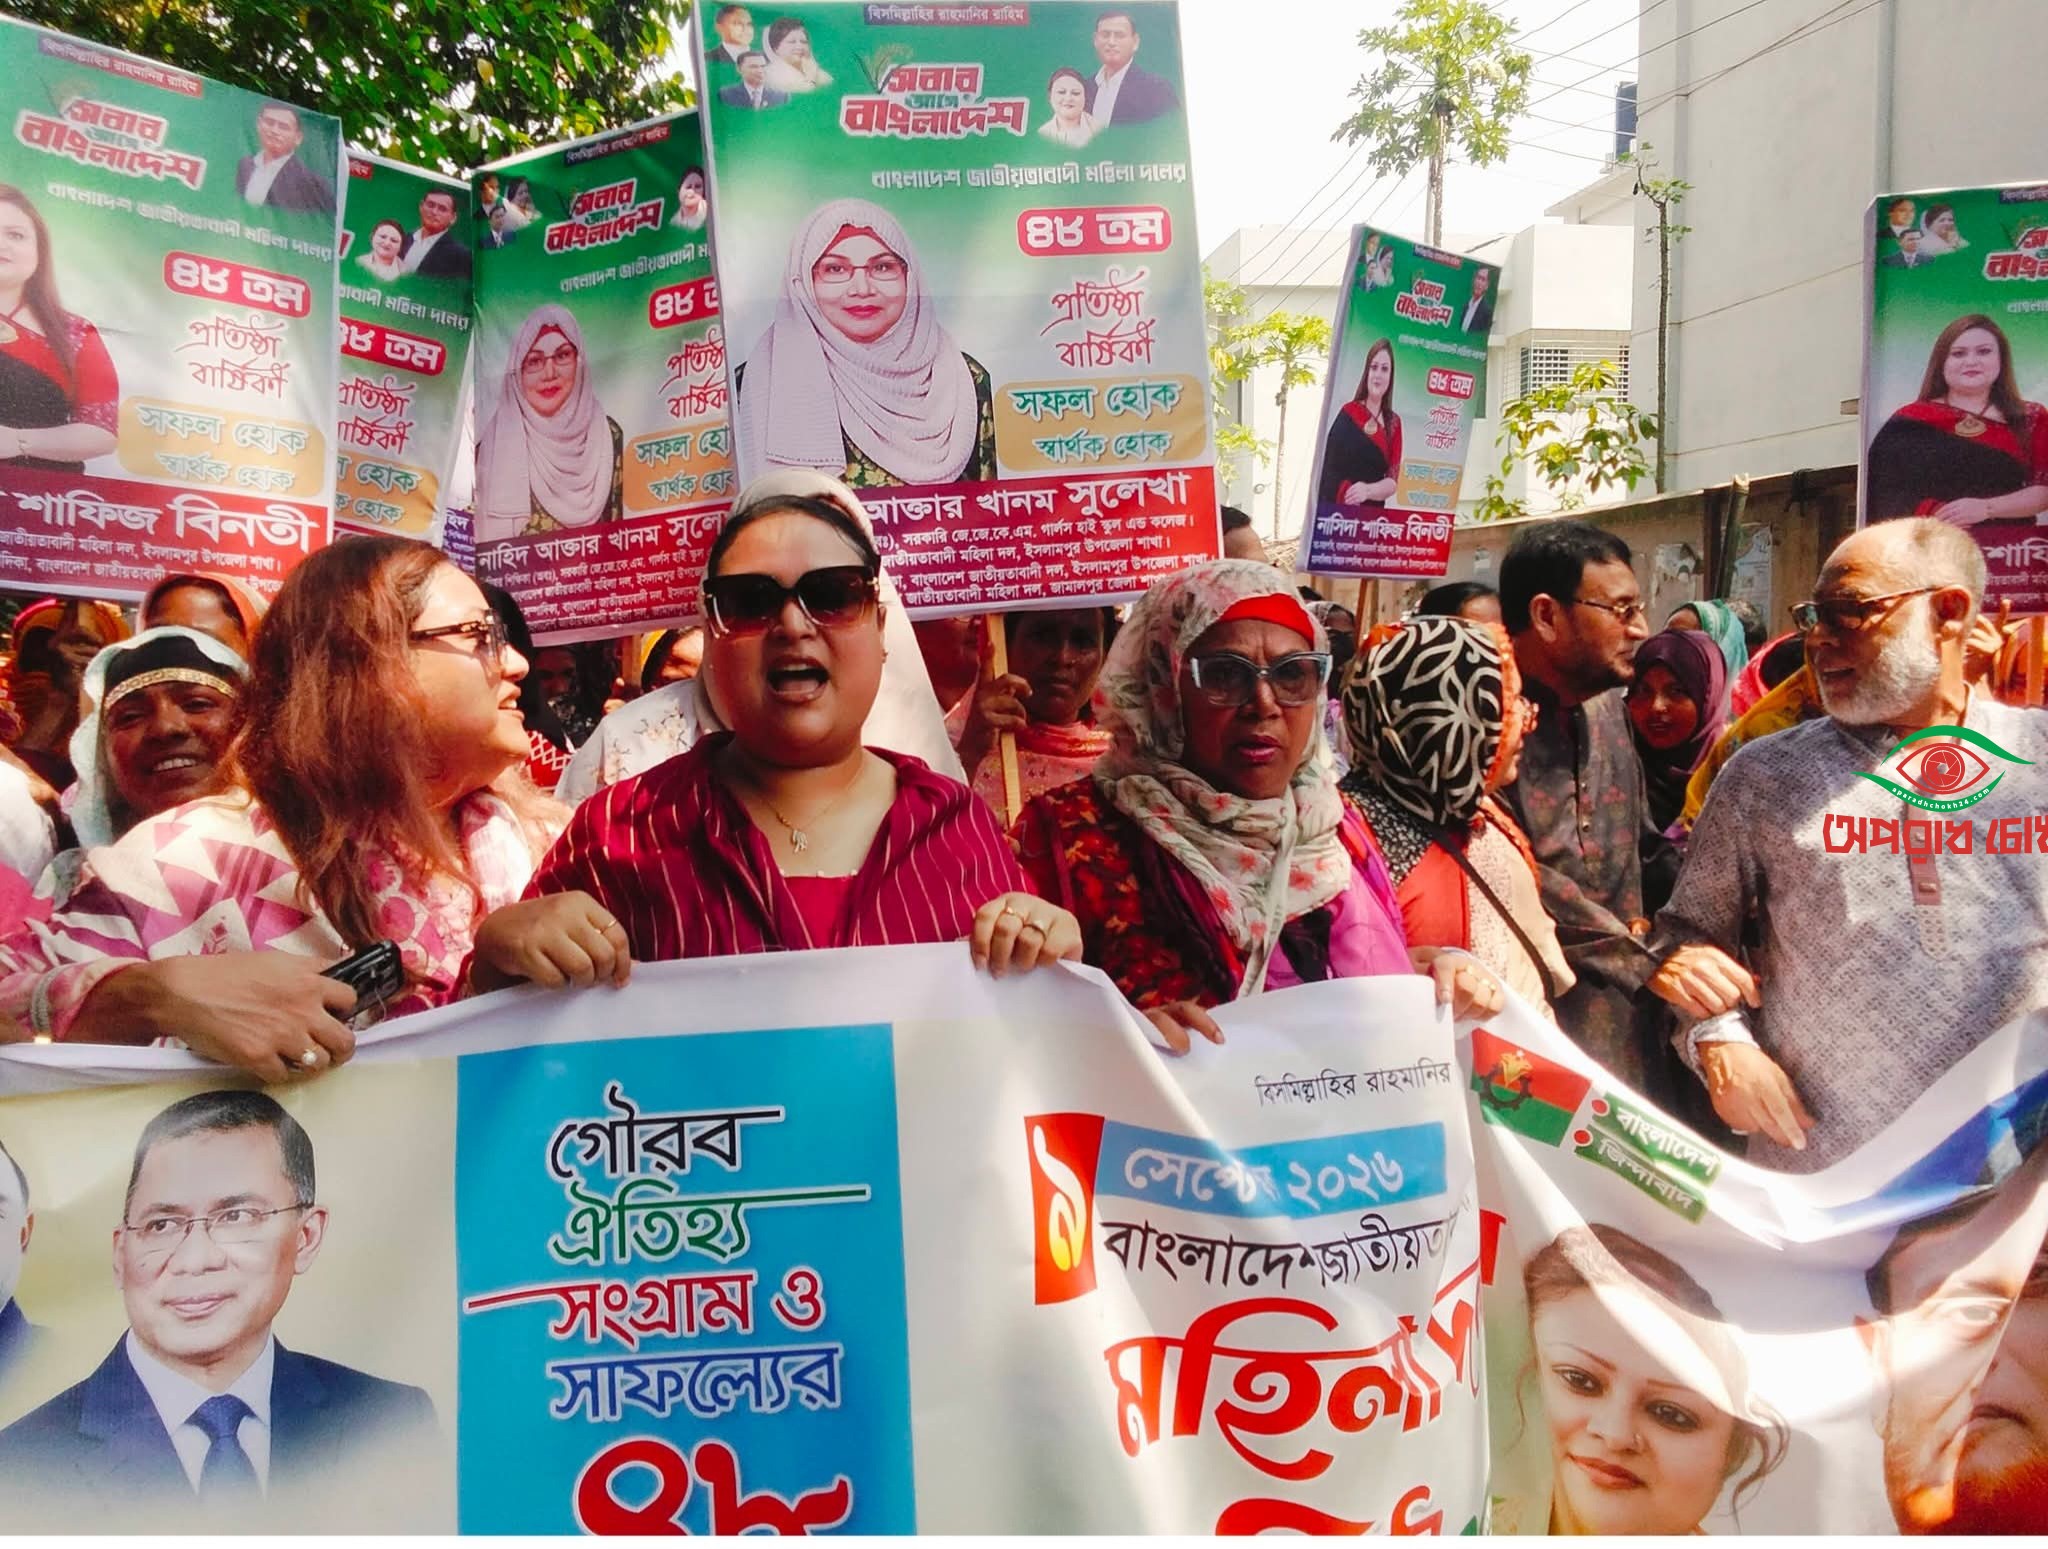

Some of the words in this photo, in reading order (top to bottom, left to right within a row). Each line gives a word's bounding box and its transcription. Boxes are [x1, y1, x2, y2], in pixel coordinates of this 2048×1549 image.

[938, 4, 988, 21] রাহমানির
[991, 4, 1025, 21] রাহিম
[887, 66, 980, 94] সবার
[68, 99, 162, 142] সবার
[844, 99, 1026, 137] বাংলাদেশ
[20, 114, 202, 187] বাংলাদেশ
[872, 167, 962, 189] বাংলাদেশ
[966, 161, 1080, 188] জাতীয়তাবাদী
[1085, 160, 1135, 184] মহিলা
[1139, 162, 1186, 184] দলের
[48, 181, 133, 212] বাংলাদেশ
[136, 200, 241, 238] জাতীয়তাবাদী
[244, 222, 288, 250] মহিলা
[575, 180, 635, 215] সবার
[546, 201, 662, 251] বাংলাদেশ
[1025, 214, 1085, 249] ৪৮
[1095, 210, 1164, 246] তম
[171, 256, 230, 295] ৪৮
[241, 270, 306, 312] তম
[560, 266, 617, 292] বাংলাদেশ
[654, 286, 696, 322] ৪৮
[1040, 268, 1146, 336] প্রতিষ্ঠা
[174, 314, 286, 358] প্রতিষ্ঠা
[384, 332, 442, 371] তম
[1055, 318, 1156, 368] বার্ষিকী
[188, 356, 291, 400] বার্ষিকী
[1011, 385, 1097, 420] সফল
[1105, 380, 1181, 419] হোক
[137, 404, 223, 443] সফল
[233, 420, 308, 454] হোক
[636, 431, 692, 466] সফল
[1035, 429, 1104, 462] স্বার্থক
[1114, 431, 1172, 459] হোক
[235, 463, 296, 492] হোক
[356, 462, 422, 494] হোক
[649, 472, 696, 501] স্বার্থক
[353, 498, 404, 525] হোক
[862, 492, 966, 524] আক্তার
[976, 487, 1058, 518] খানম
[1063, 471, 1192, 517] সুলেখা
[12, 489, 163, 535] শাফিজ
[166, 493, 321, 554] বিনতী
[903, 526, 948, 546] সরকারি
[1041, 518, 1073, 537] গার্লস
[1077, 517, 1097, 534] হাই
[78, 535, 114, 555] মহিলা
[477, 542, 530, 571] নাহিদ
[533, 534, 602, 561] আক্তার
[608, 525, 662, 551] খানম
[959, 546, 994, 564] মহিলা
[1023, 541, 1081, 560] ইসলামপুর
[1083, 537, 1133, 553] উপজেলা
[36, 558, 92, 577] বাংলাদেশ
[93, 559, 166, 582] জাতীয়তাবাদী
[911, 569, 965, 588] বাংলাদেশ
[968, 561, 1042, 584] জাতীয়তাবাদী
[1071, 558, 1128, 576] ইসলামপুর
[906, 584, 982, 606] জাতীয়তাবাদী
[985, 583, 1020, 601] মহিলা
[1107, 575, 1137, 589] জেলা
[1364, 1056, 1451, 1094] রাহমানির
[550, 1085, 781, 1177] গৌরব
[1616, 1106, 1722, 1176] বাংলাদেশ
[1287, 1151, 1404, 1211] ২০২৬
[1598, 1139, 1696, 1210] জিন্দাবাদ
[552, 1179, 867, 1259] ঐতিহ্য
[468, 1273, 754, 1346] সংগ্রাম
[776, 1270, 823, 1328] ও
[551, 1347, 840, 1417] সাফল্যের
[1103, 1297, 1441, 1481] মহিলা
